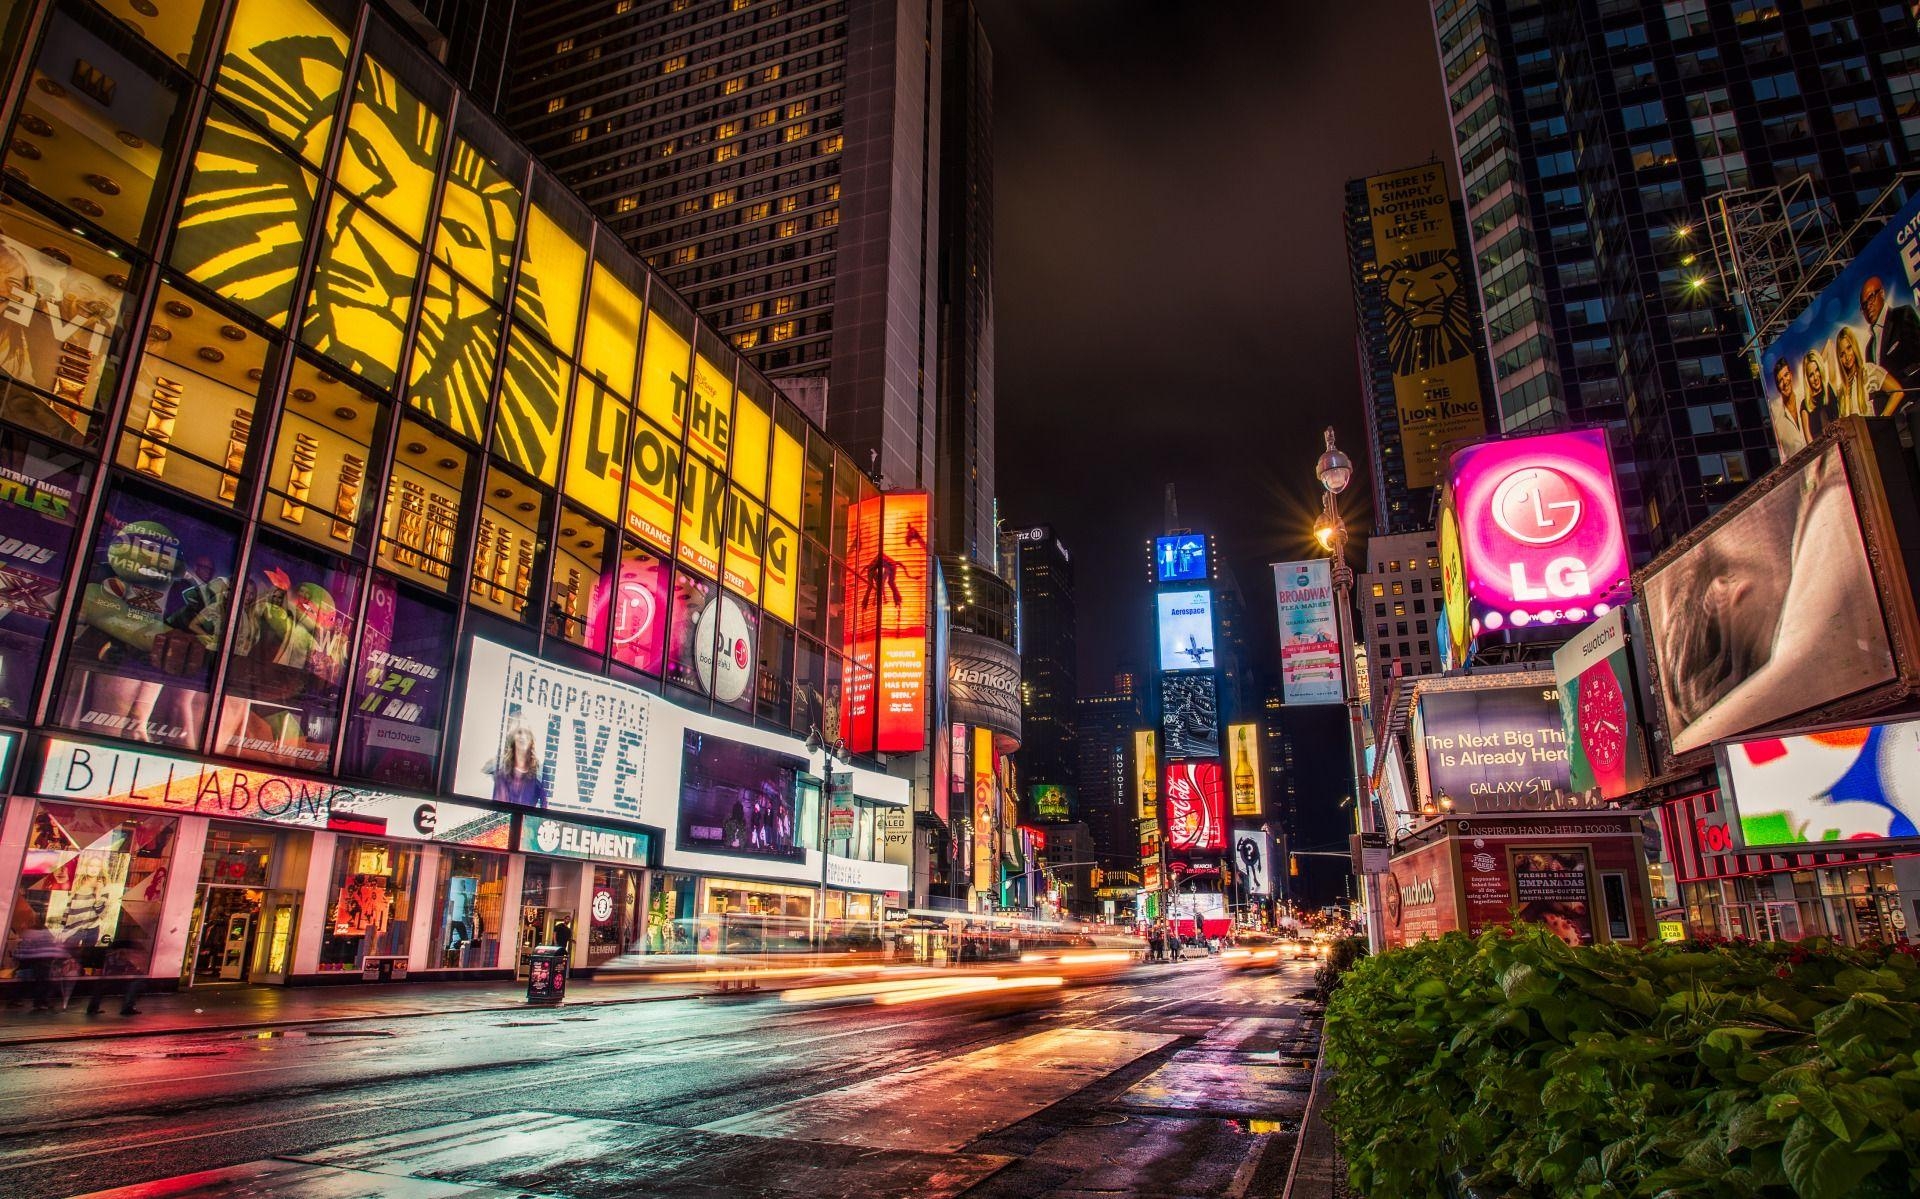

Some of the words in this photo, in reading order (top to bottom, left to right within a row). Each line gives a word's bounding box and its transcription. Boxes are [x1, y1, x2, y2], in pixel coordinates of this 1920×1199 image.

[1423, 172, 1436, 182] IS
[1382, 185, 1432, 202] SIMPLY
[1373, 194, 1445, 216] NOTHING
[1395, 210, 1427, 224] ELSE
[1385, 224, 1418, 239] LIKE
[1424, 387, 1450, 400] THE
[670, 371, 728, 452] THE
[1401, 407, 1437, 426] LION
[1440, 401, 1479, 420] KING
[585, 368, 697, 514] LION
[700, 453, 788, 575] KING
[36, 481, 73, 500] NINJA
[630, 514, 671, 545] ENTRANCE
[681, 545, 694, 560] ON
[697, 554, 716, 572] 45TH
[723, 571, 745, 590] STREET
[1510, 556, 1591, 601] LG
[1279, 587, 1330, 604] BROADWAY
[1171, 606, 1205, 616] Aerospace
[1281, 604, 1299, 612] FLEA
[1301, 601, 1331, 610] MARKET
[1306, 616, 1330, 624] AUCTION
[1582, 628, 1610, 658] swatch
[367, 649, 440, 679] SATURDAY
[883, 661, 921, 669] ANYTHING
[883, 671, 922, 679] BROADWAY
[901, 681, 919, 689] EVER
[953, 668, 1018, 697] Hankook
[511, 668, 646, 732] AÉROPOSTALE
[382, 698, 424, 723] AM
[1425, 735, 1454, 750] The
[1458, 731, 1500, 748] Next
[1504, 729, 1534, 747] Big
[509, 702, 643, 811] IVE
[1440, 752, 1455, 767] Is
[1460, 748, 1526, 767] Already
[65, 748, 357, 824] BILLABONG
[1116, 754, 1124, 805] NOVOTEL
[1469, 780, 1523, 795] GALAXY
[976, 771, 992, 848] Kodak
[1470, 826, 1516, 836] INSPIRED
[1519, 825, 1583, 835] HAND-HELD
[1585, 824, 1622, 833] FOODS
[561, 827, 636, 859] ELEMENT
[1402, 875, 1435, 907] nuchas
[1519, 879, 1585, 887] EMPANADAS
[590, 945, 617, 954] ELEMENT
